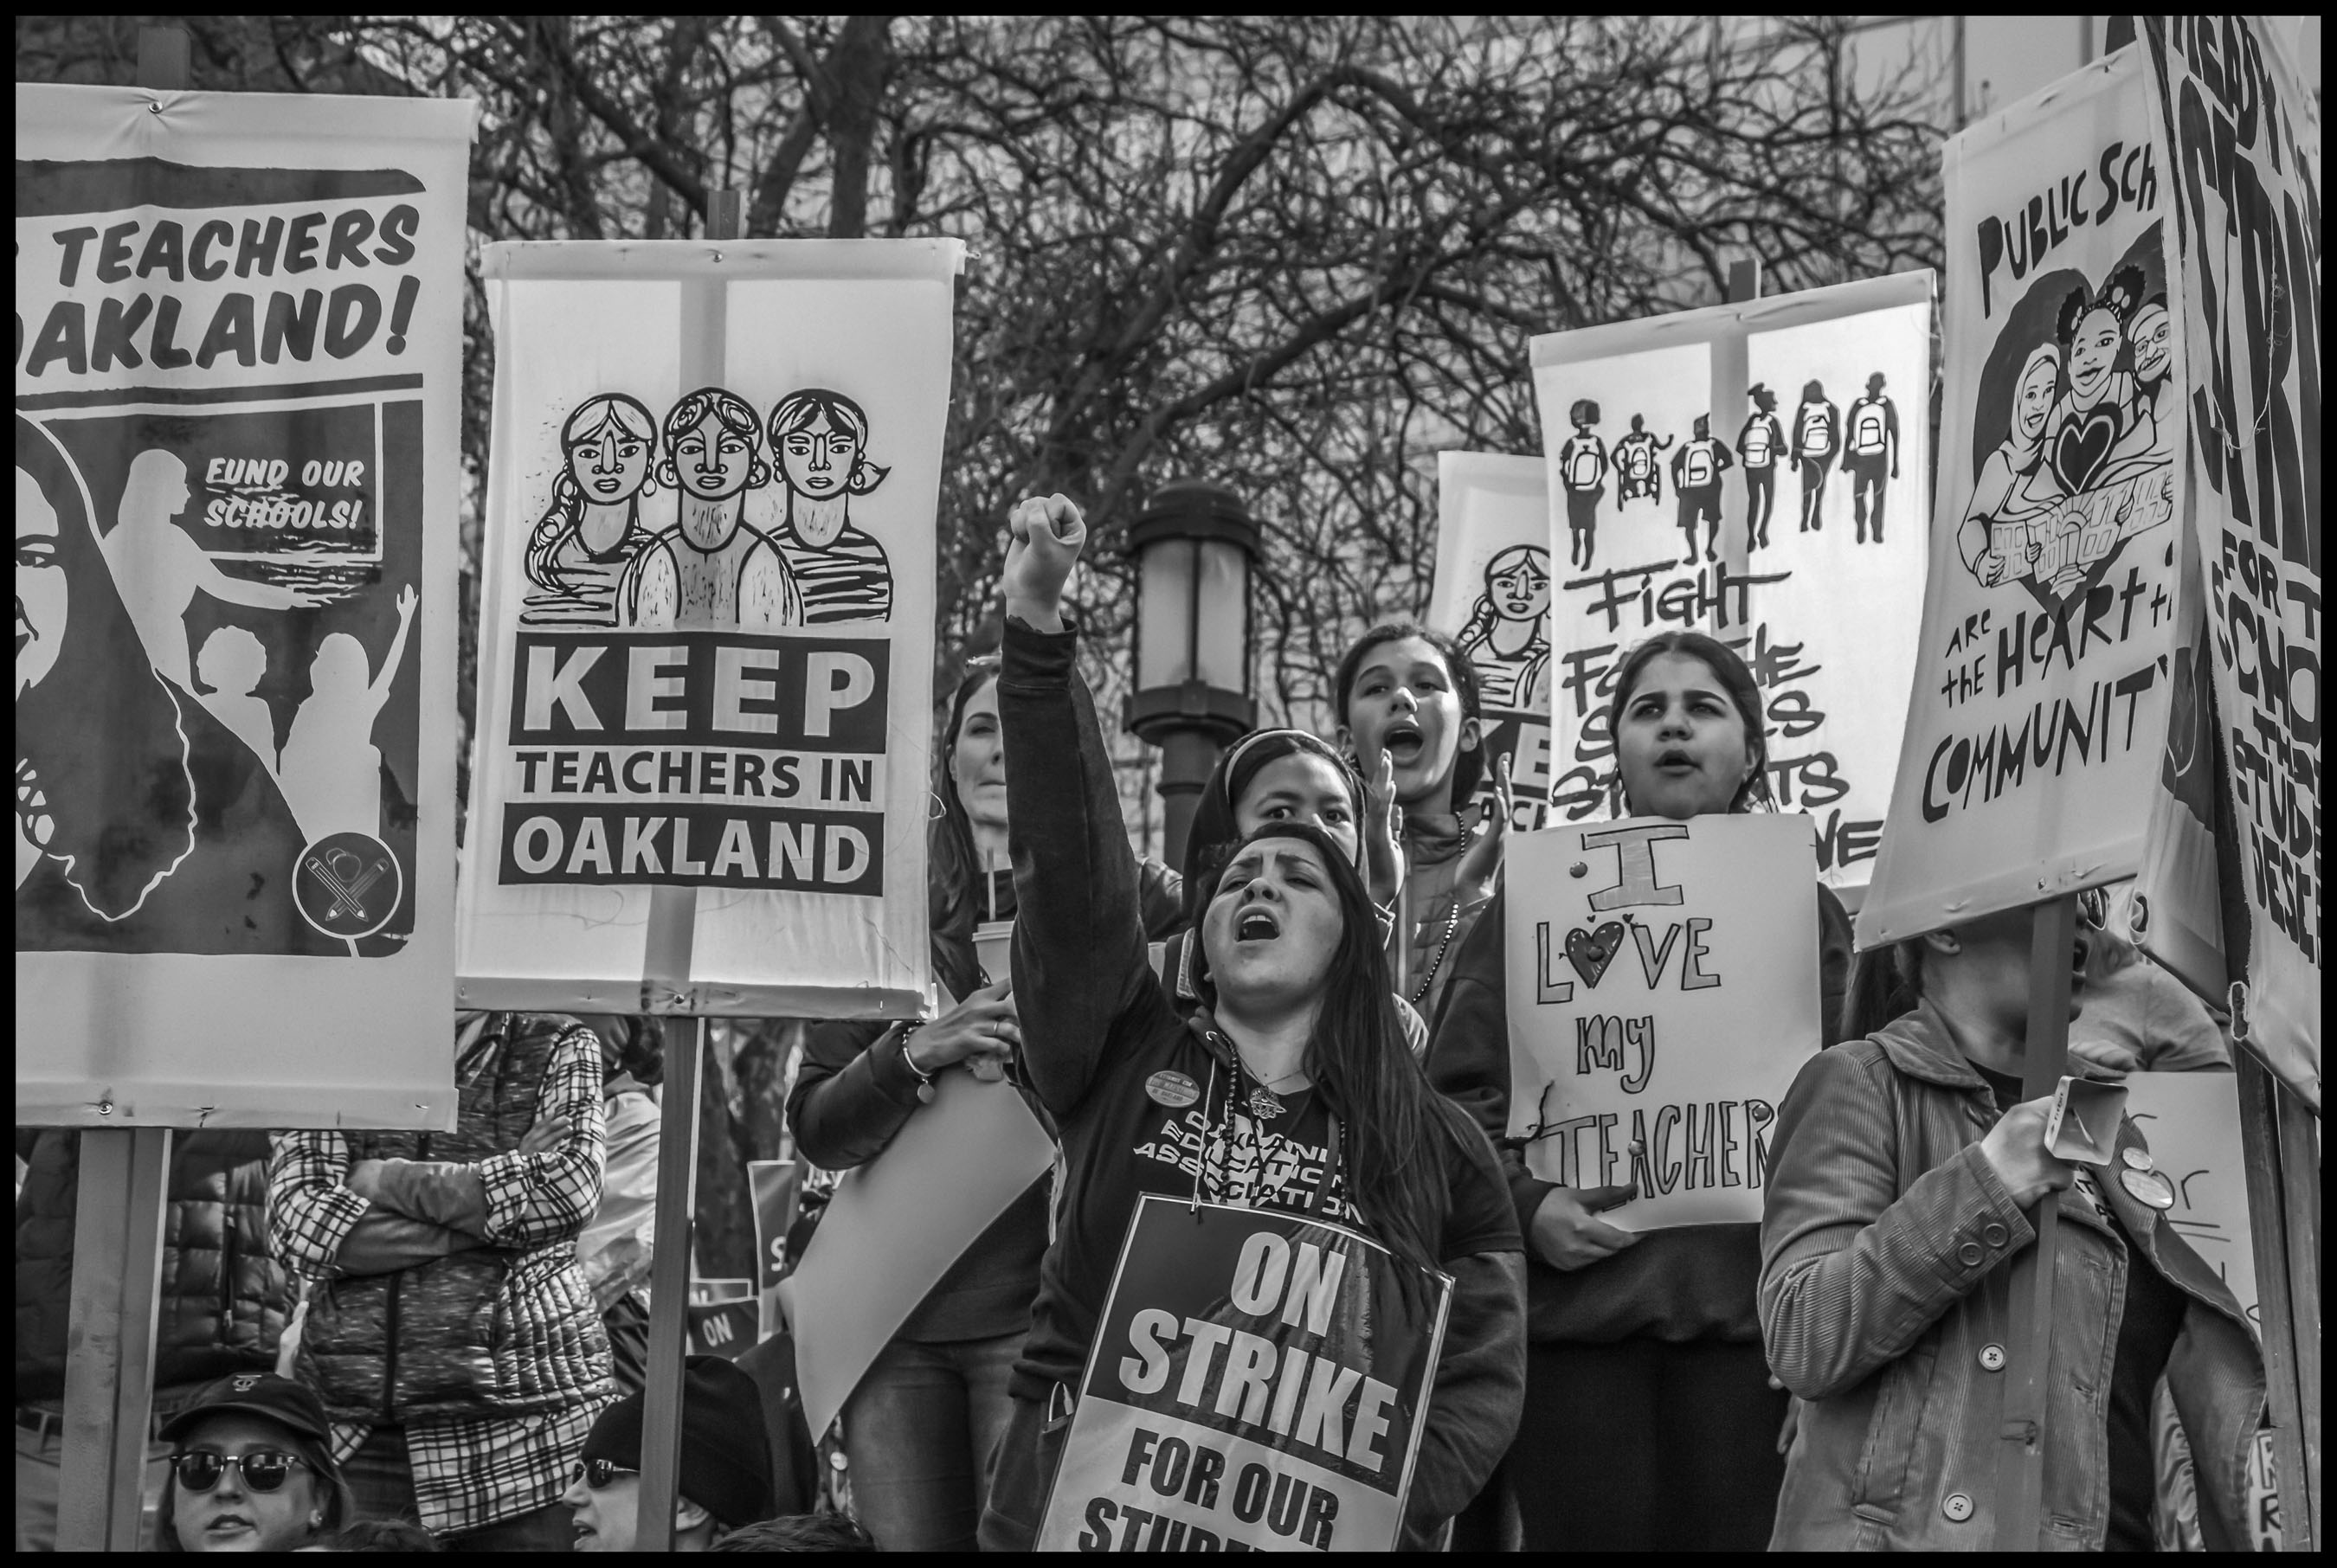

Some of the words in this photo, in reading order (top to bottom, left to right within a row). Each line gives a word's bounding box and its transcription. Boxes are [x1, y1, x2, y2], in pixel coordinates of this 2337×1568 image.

[52, 204, 421, 287] TEACHERS
[1977, 170, 2089, 320] PUBLIC
[16, 274, 421, 377] AKLAND!
[203, 498, 364, 530] SCHOOLS!
[301, 459, 364, 487] OUR
[2222, 527, 2282, 619] FOR
[523, 646, 875, 737] KEEP
[515, 750, 801, 799] TEACHERS
[820, 758, 873, 802] IN
[512, 815, 870, 884] OAKLAND
[1581, 824, 1690, 912] I
[1538, 1099, 1783, 1213] TEACHER
[702, 1312, 735, 1347] ON
[1231, 1231, 1346, 1337] ON
[1118, 1308, 1398, 1473] STRIKE
[1121, 1427, 1226, 1510] FOR
[1233, 1462, 1339, 1552] OUR
